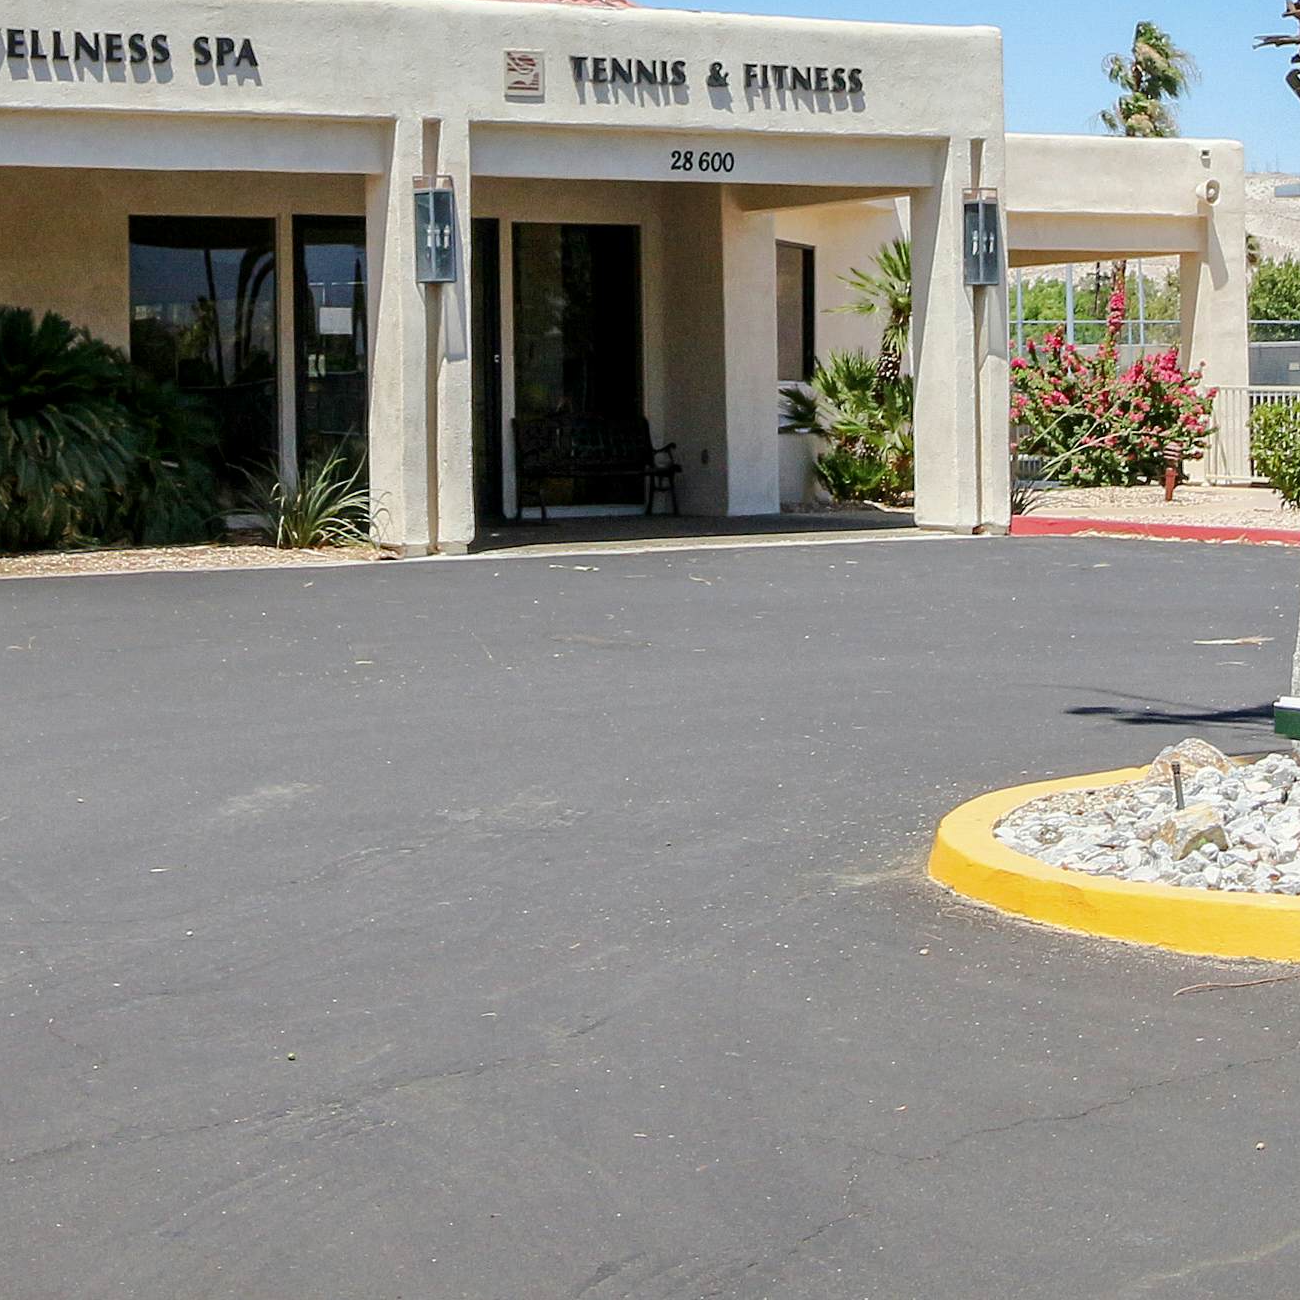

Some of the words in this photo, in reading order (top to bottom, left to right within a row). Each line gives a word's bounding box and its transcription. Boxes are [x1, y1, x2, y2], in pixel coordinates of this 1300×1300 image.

[194, 36, 258, 67] SPA
[569, 55, 686, 85] TENNIS
[707, 62, 729, 87] &
[743, 62, 863, 93] FITNESS
[670, 150, 735, 173] 28600
